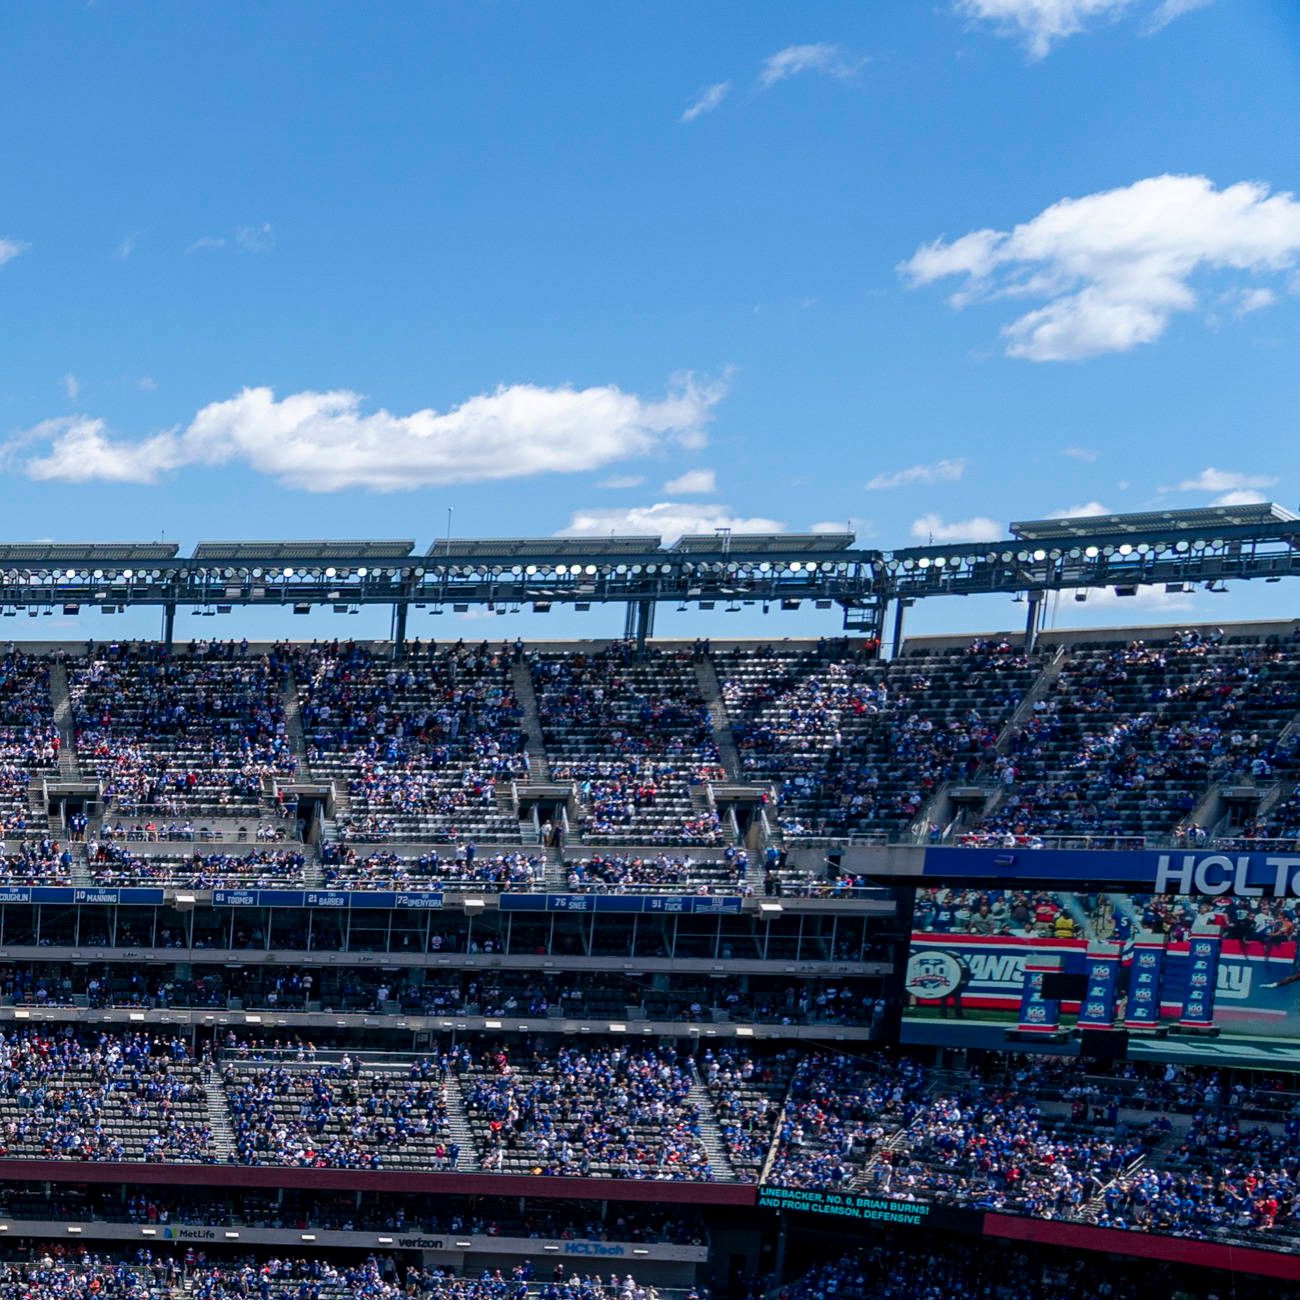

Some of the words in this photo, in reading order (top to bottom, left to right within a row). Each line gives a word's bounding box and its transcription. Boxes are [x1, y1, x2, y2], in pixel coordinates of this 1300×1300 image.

[1154, 855, 1300, 897] HCLT
[76, 891, 86, 899] 10
[87, 894, 117, 902] MANNING
[215, 894, 225, 902] 81
[227, 896, 254, 904] TOOMER
[308, 895, 318, 903] 21
[318, 897, 344, 906] BARBER
[760, 1187, 824, 1204] LINEBACKER,
[826, 1195, 843, 1204] NO.
[856, 1198, 888, 1209] BRIAN
[889, 1202, 929, 1215] BURNS!
[759, 1197, 779, 1208] AND
[781, 1200, 809, 1212] FROM
[811, 1202, 862, 1218] CLEMSON,
[863, 1208, 921, 1225] DEFENSIVE
[180, 1229, 215, 1239] MetLife
[399, 1237, 443, 1249] verizon
[564, 1242, 625, 1255] HCLTech
